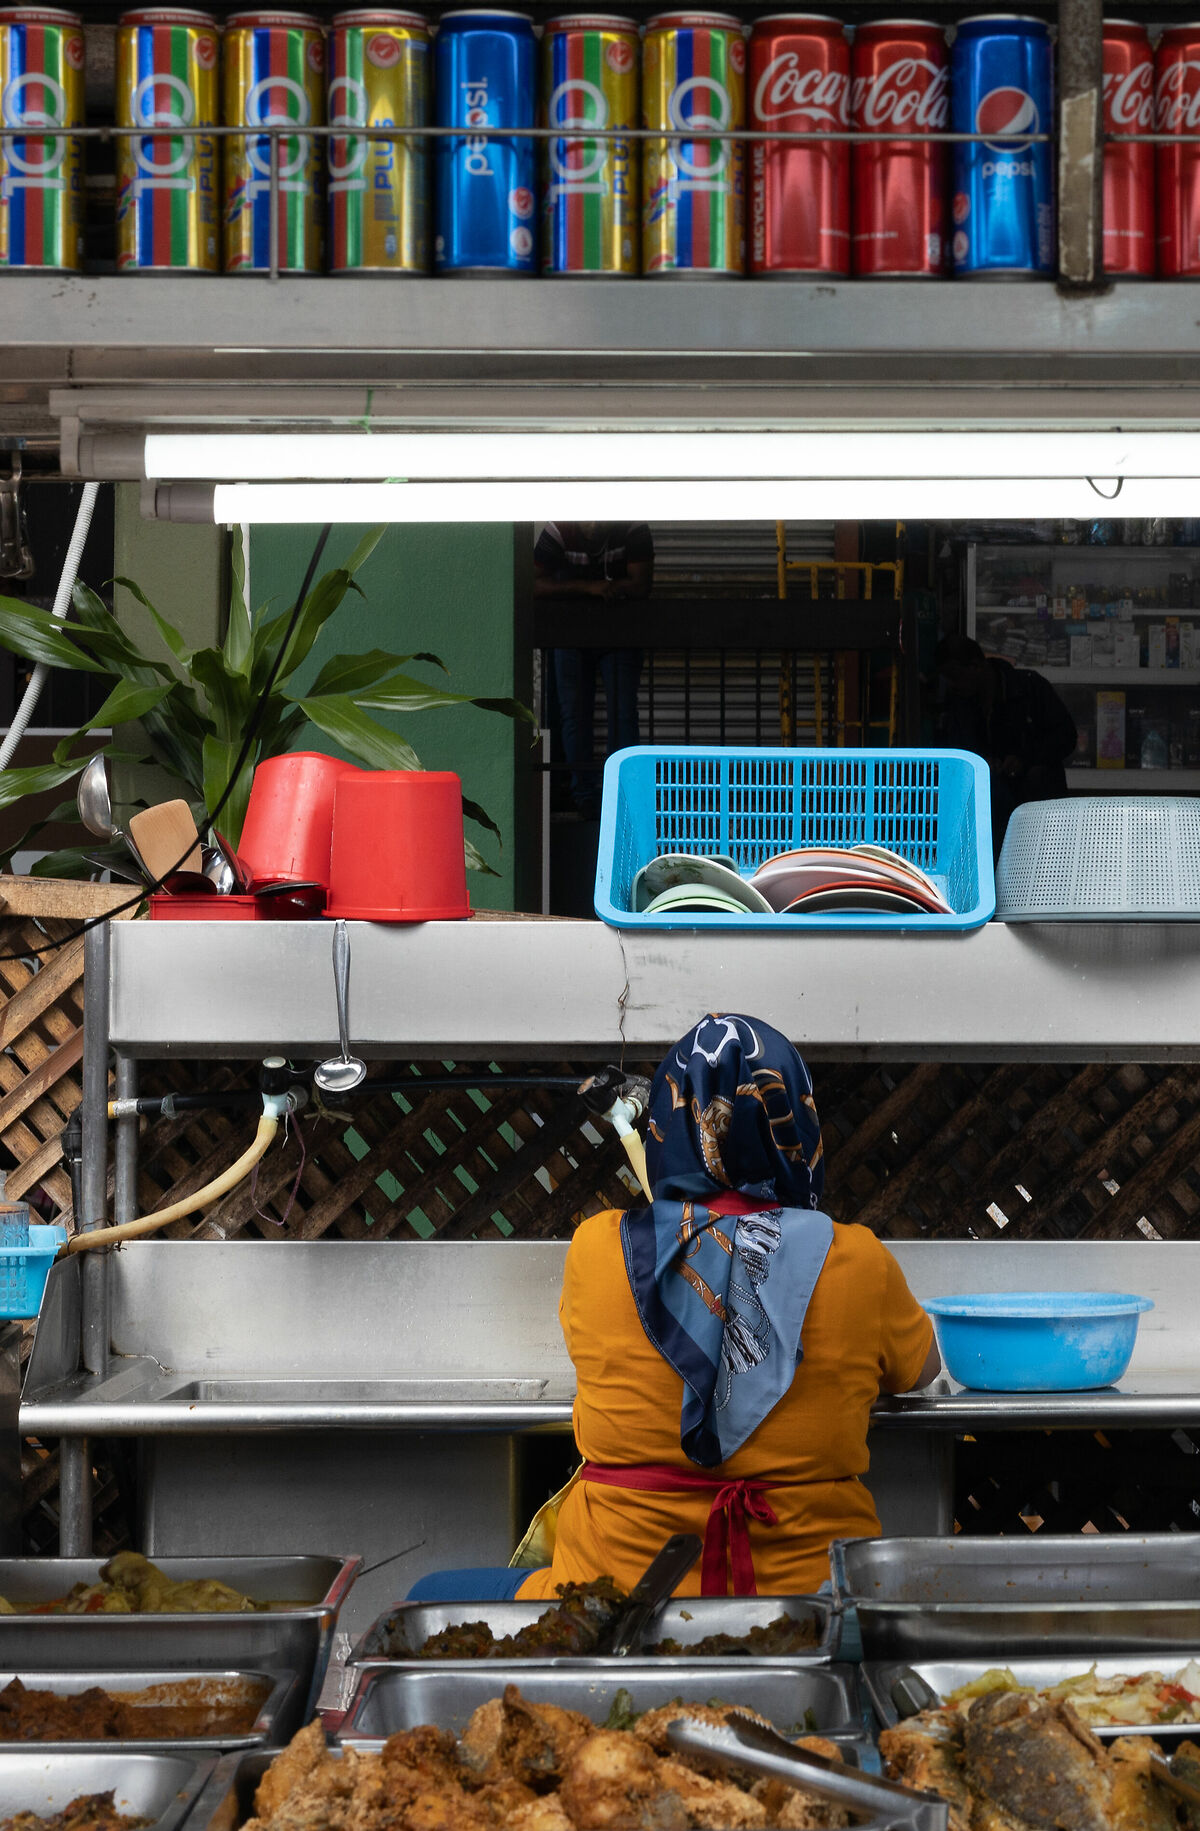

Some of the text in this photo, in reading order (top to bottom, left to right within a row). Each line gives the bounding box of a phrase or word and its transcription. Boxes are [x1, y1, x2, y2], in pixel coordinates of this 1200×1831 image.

[373, 117, 395, 190] PLUS
[982, 159, 1036, 179] pepsi
[754, 145, 768, 262] RECYCLE ME
